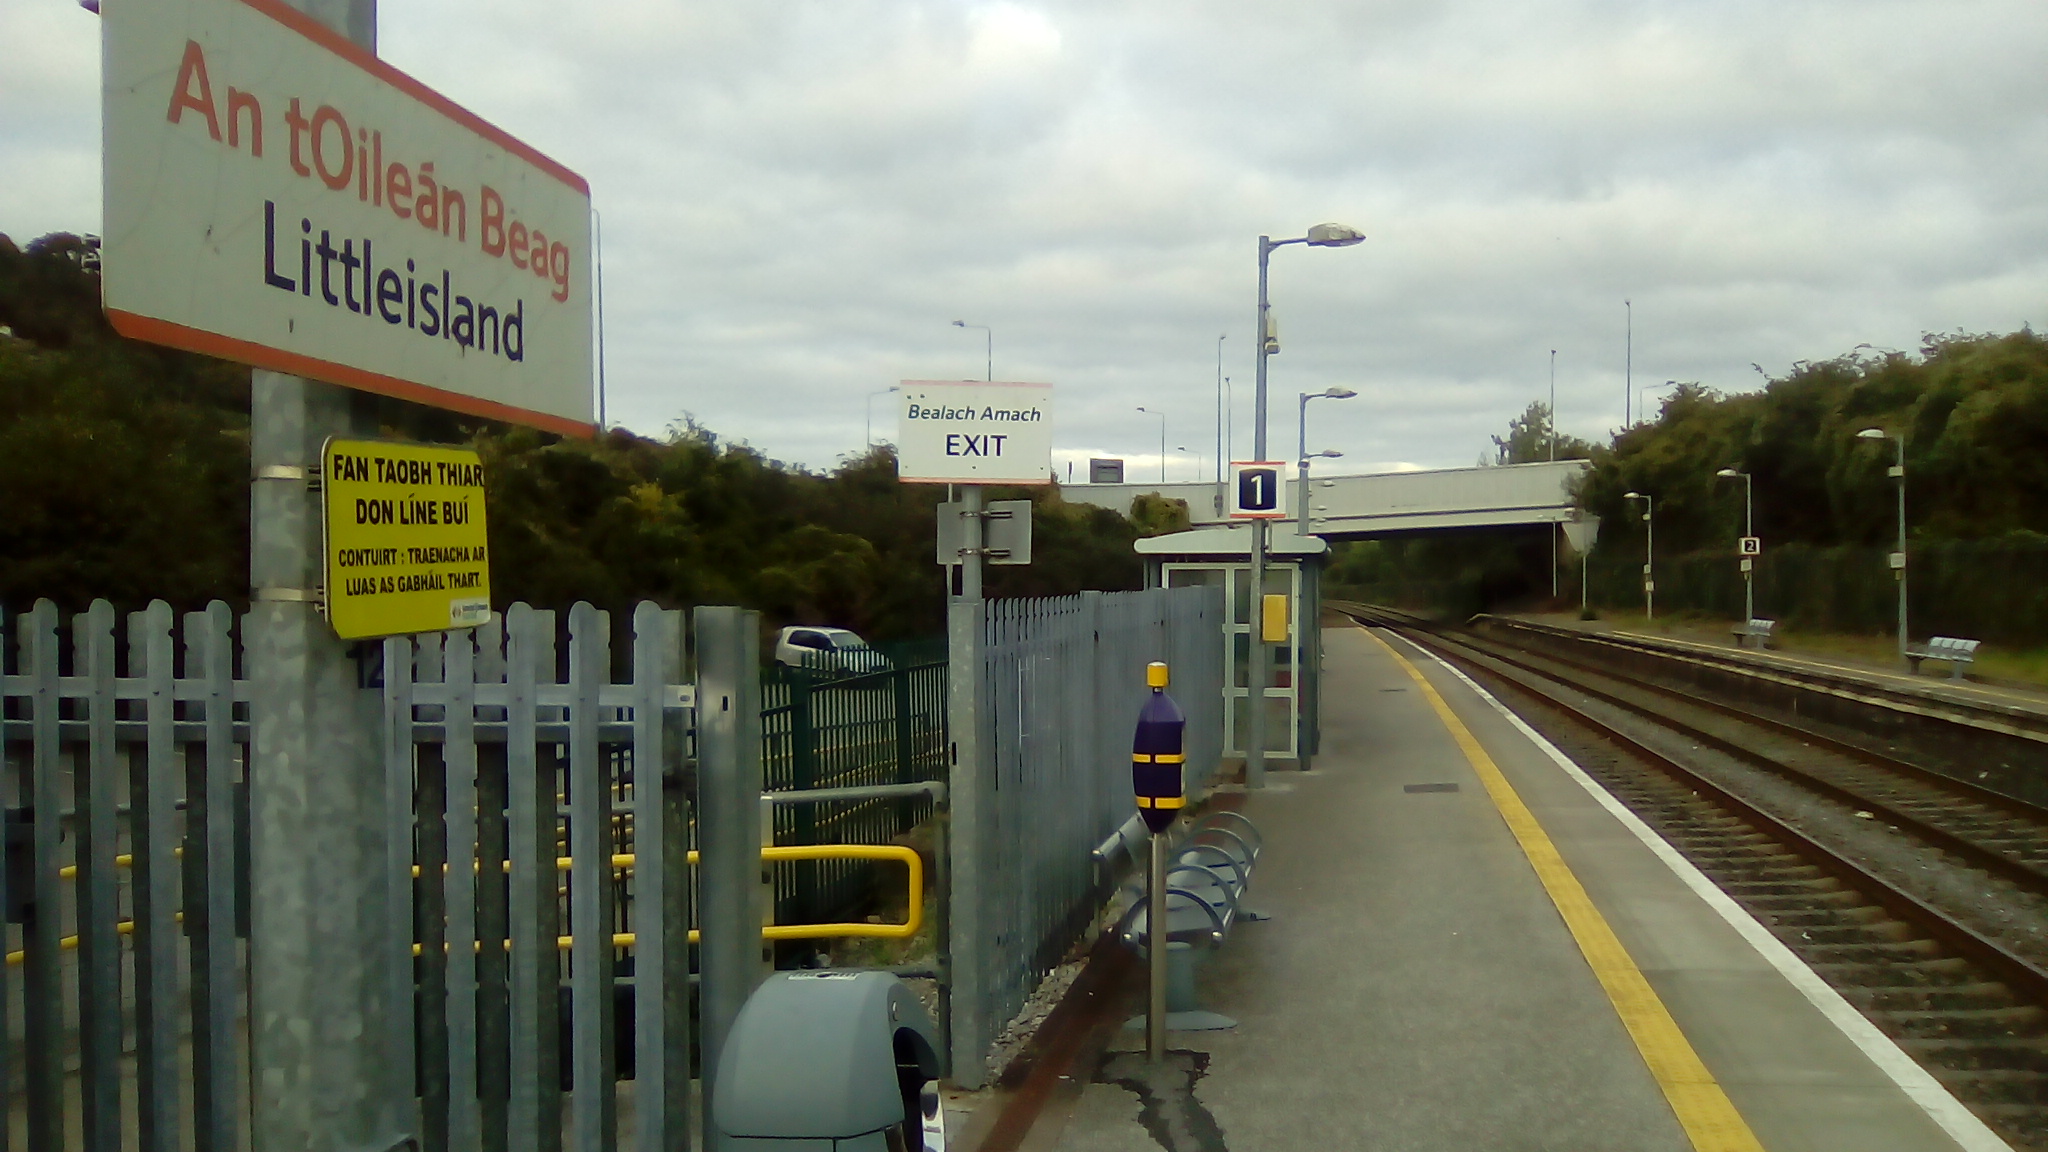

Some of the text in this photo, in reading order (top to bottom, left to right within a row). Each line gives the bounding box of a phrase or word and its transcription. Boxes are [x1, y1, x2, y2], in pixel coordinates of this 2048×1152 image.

[166, 38, 570, 303] An tOileán Beag
[263, 199, 524, 363] Littleisland
[908, 404, 1041, 422] Bealach Amach
[946, 434, 1007, 457] EXIT
[333, 454, 484, 487] FAN TAOBH THIAR
[1251, 475, 1262, 505] 1
[356, 492, 469, 525] DON LÍNE BUÍ
[338, 548, 398, 567] CONTUIRT
[407, 547, 470, 565] TRAENACHA
[472, 546, 485, 562] AR
[1746, 540, 1755, 551] 2
[346, 569, 481, 596] LUAS AS GABHÁIL THART.
